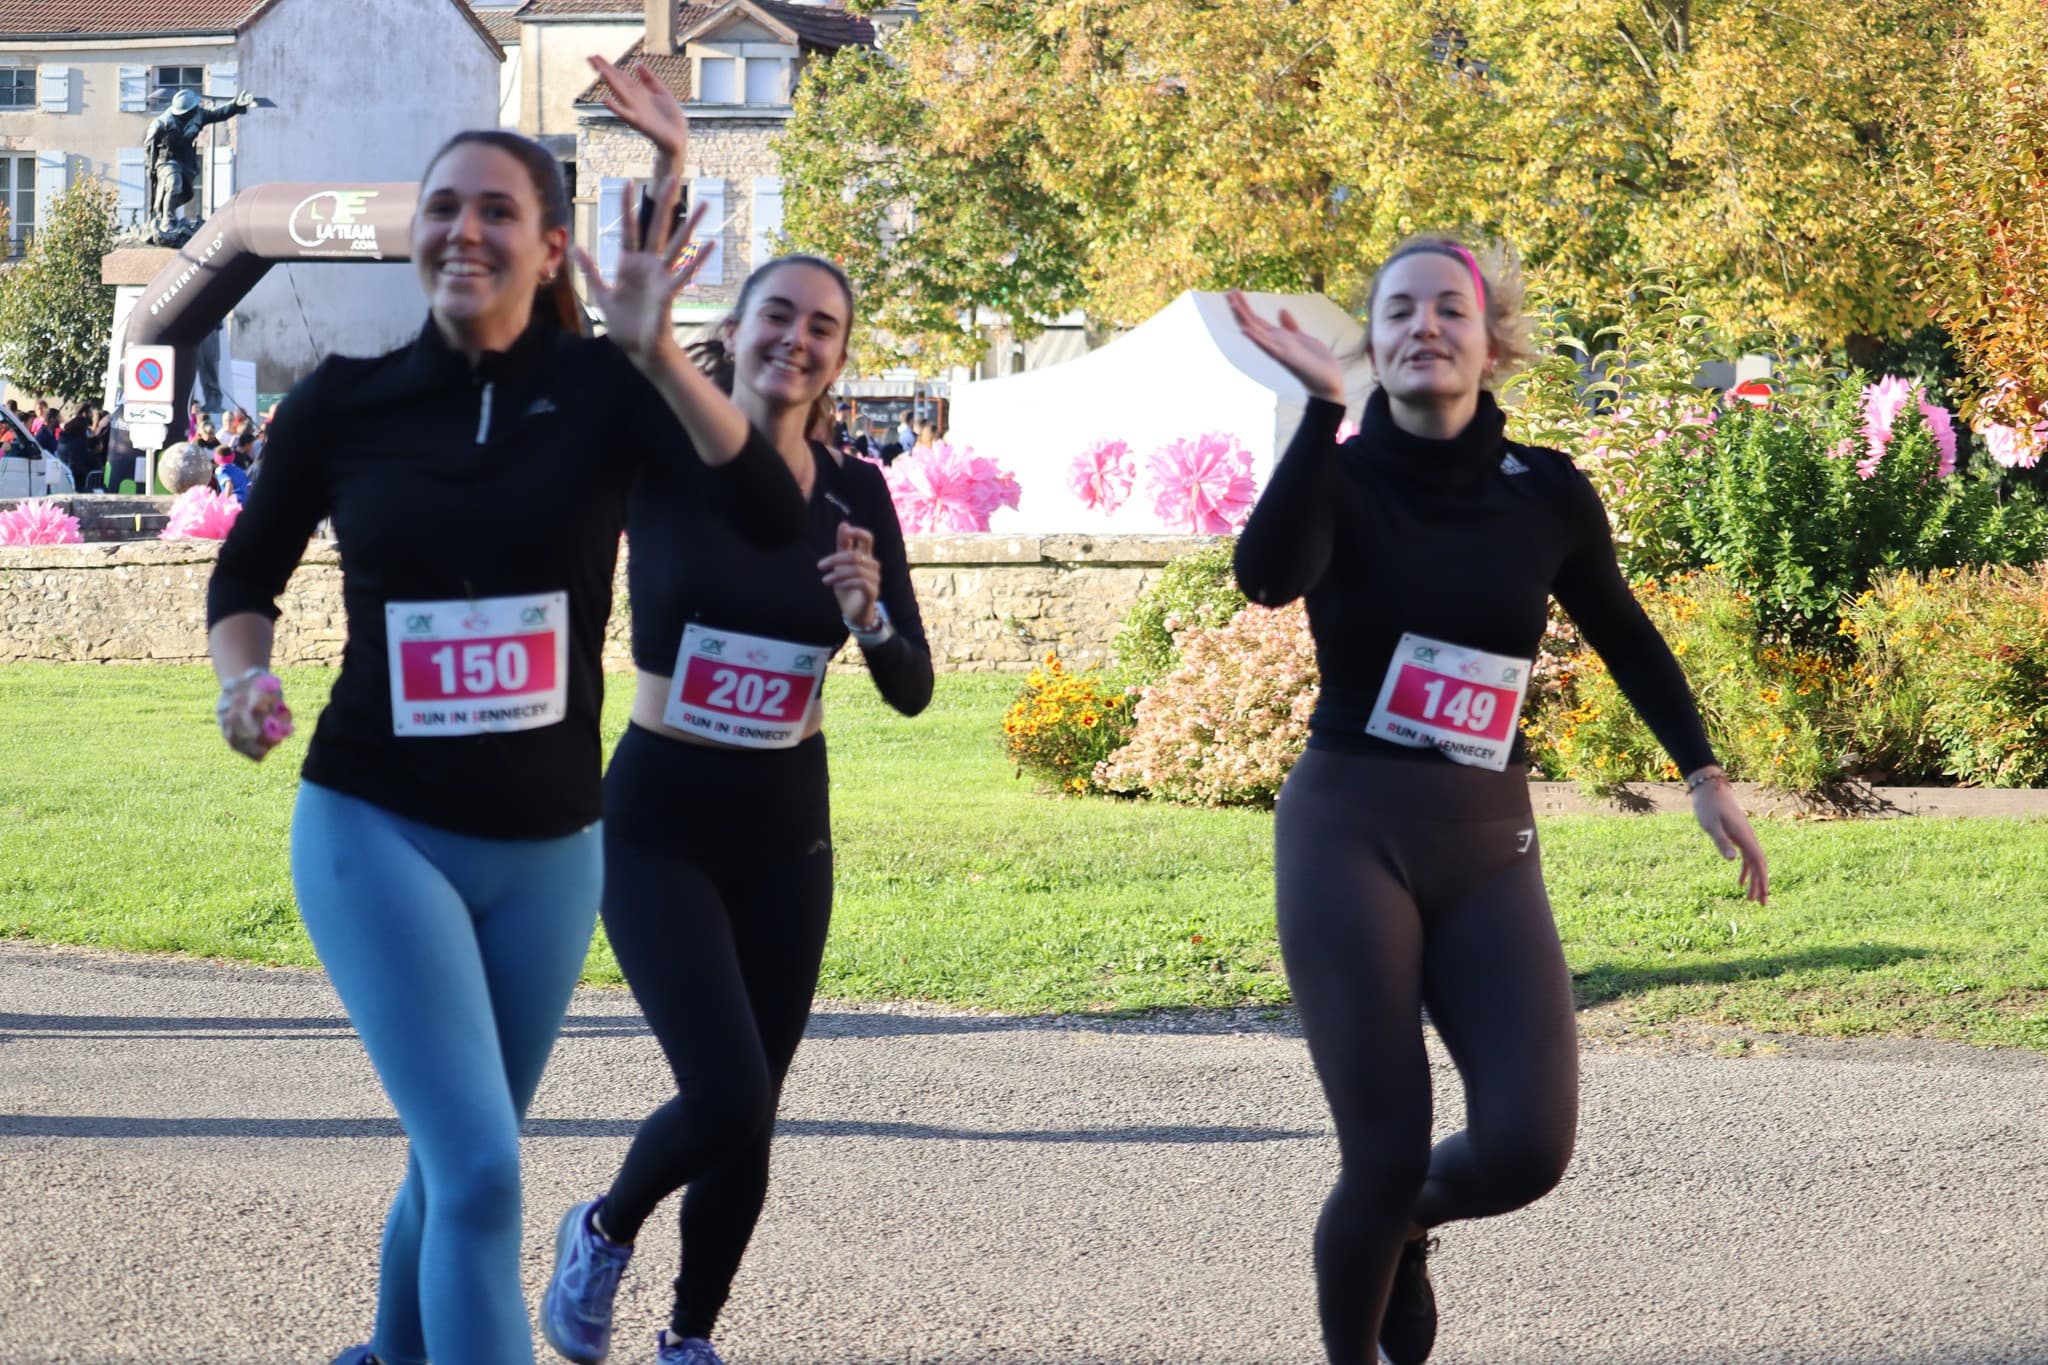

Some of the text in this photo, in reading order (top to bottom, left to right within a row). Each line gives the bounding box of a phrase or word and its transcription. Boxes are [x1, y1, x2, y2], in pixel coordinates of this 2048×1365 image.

[431, 640, 529, 694] 150
[706, 668, 791, 717] 202
[1424, 679, 1496, 732] 149
[412, 711, 445, 725] RUN
[450, 711, 467, 724] IN
[683, 713, 711, 730] RUN
[714, 721, 729, 733] IN
[1387, 722, 1416, 740] RUN
[1419, 733, 1435, 746] IN
